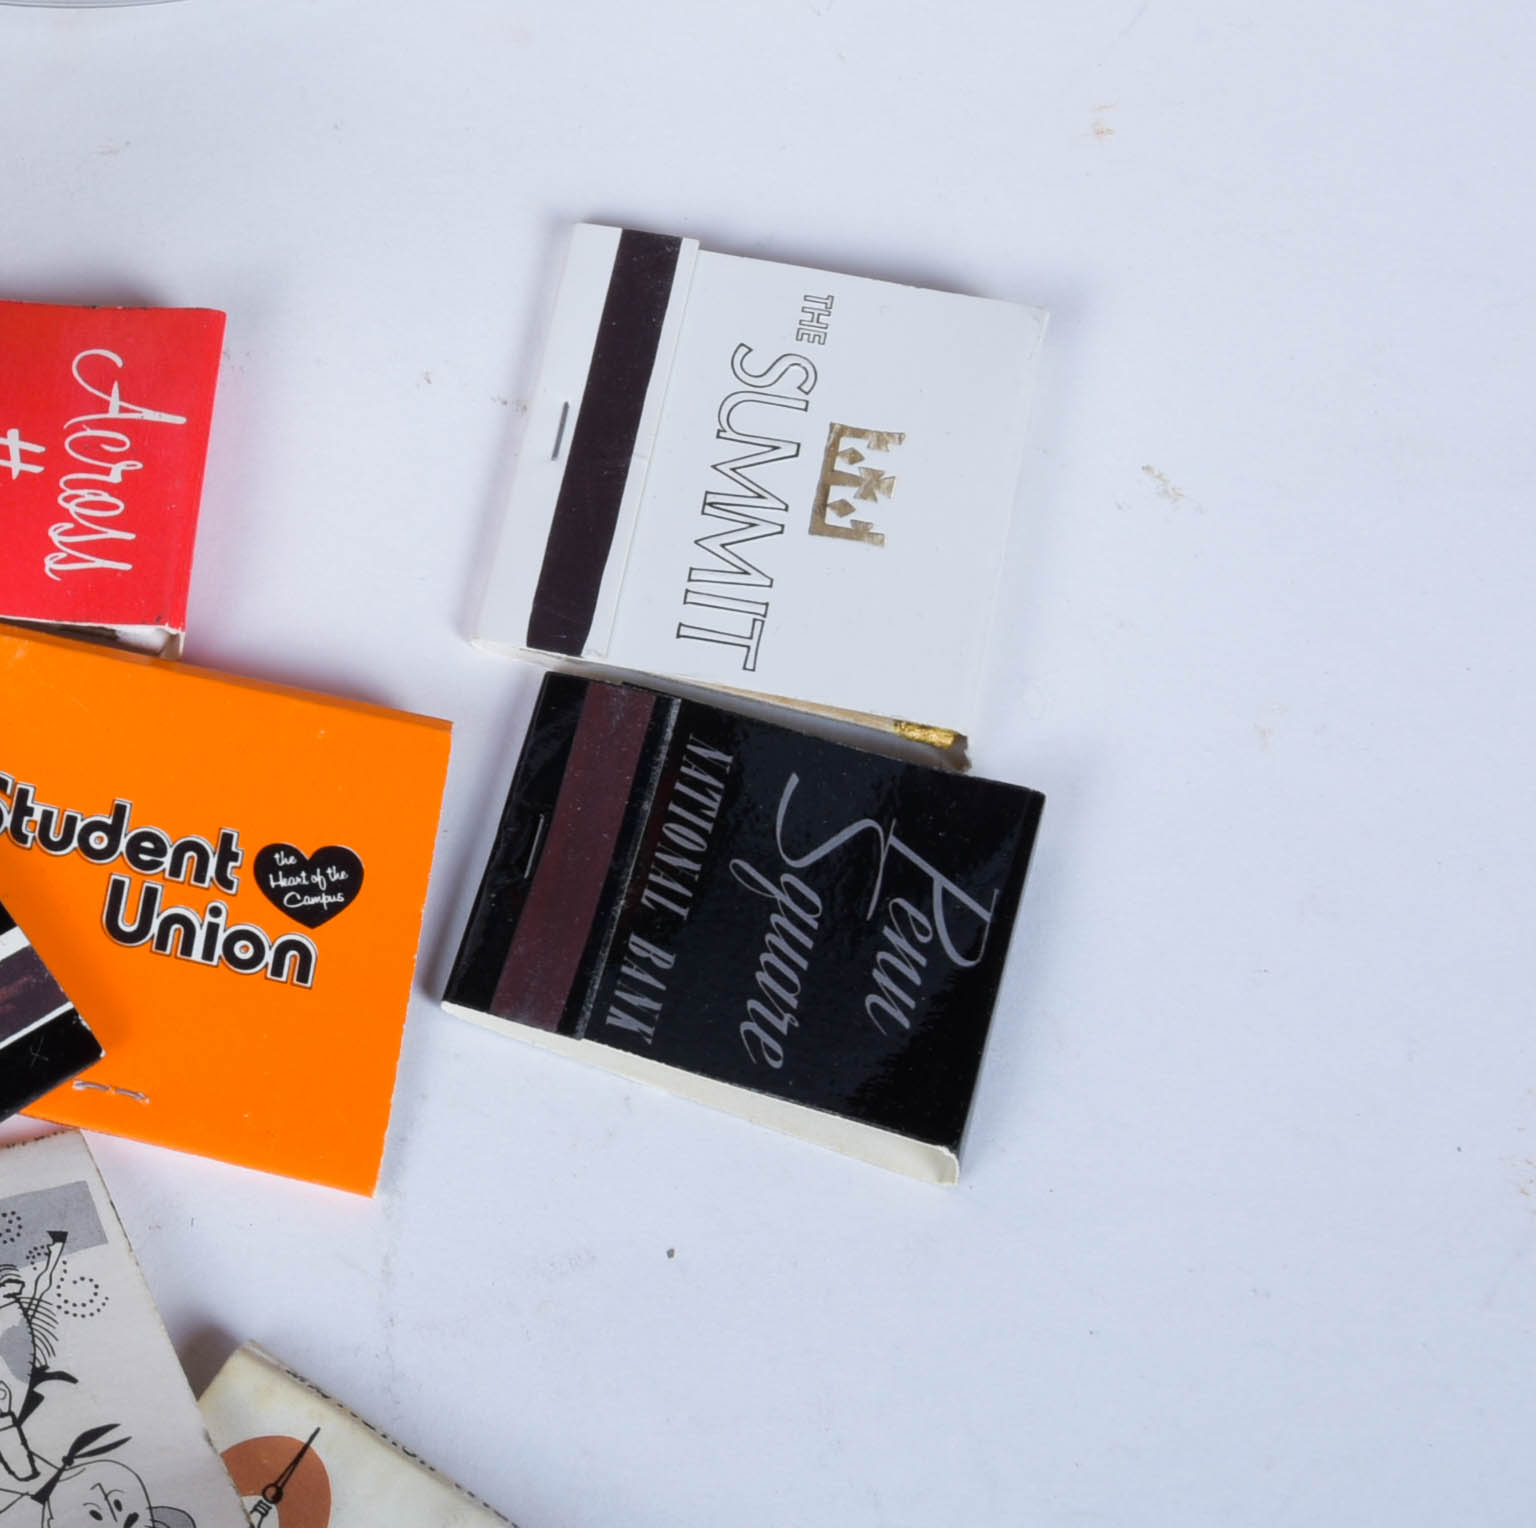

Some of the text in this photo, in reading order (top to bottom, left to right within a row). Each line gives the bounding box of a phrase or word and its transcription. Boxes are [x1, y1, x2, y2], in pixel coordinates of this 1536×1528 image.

[795, 294, 834, 345] THE
[44, 347, 186, 581] Across
[676, 342, 818, 672] SUMMIT
[102, 872, 319, 990] Union
[268, 866, 349, 891] Heart of the
[273, 851, 298, 867] the
[283, 889, 346, 910] Campus
[605, 732, 735, 1045] NATIONAL BANK
[728, 772, 886, 1070] Square
[864, 817, 1001, 1039] Penn
